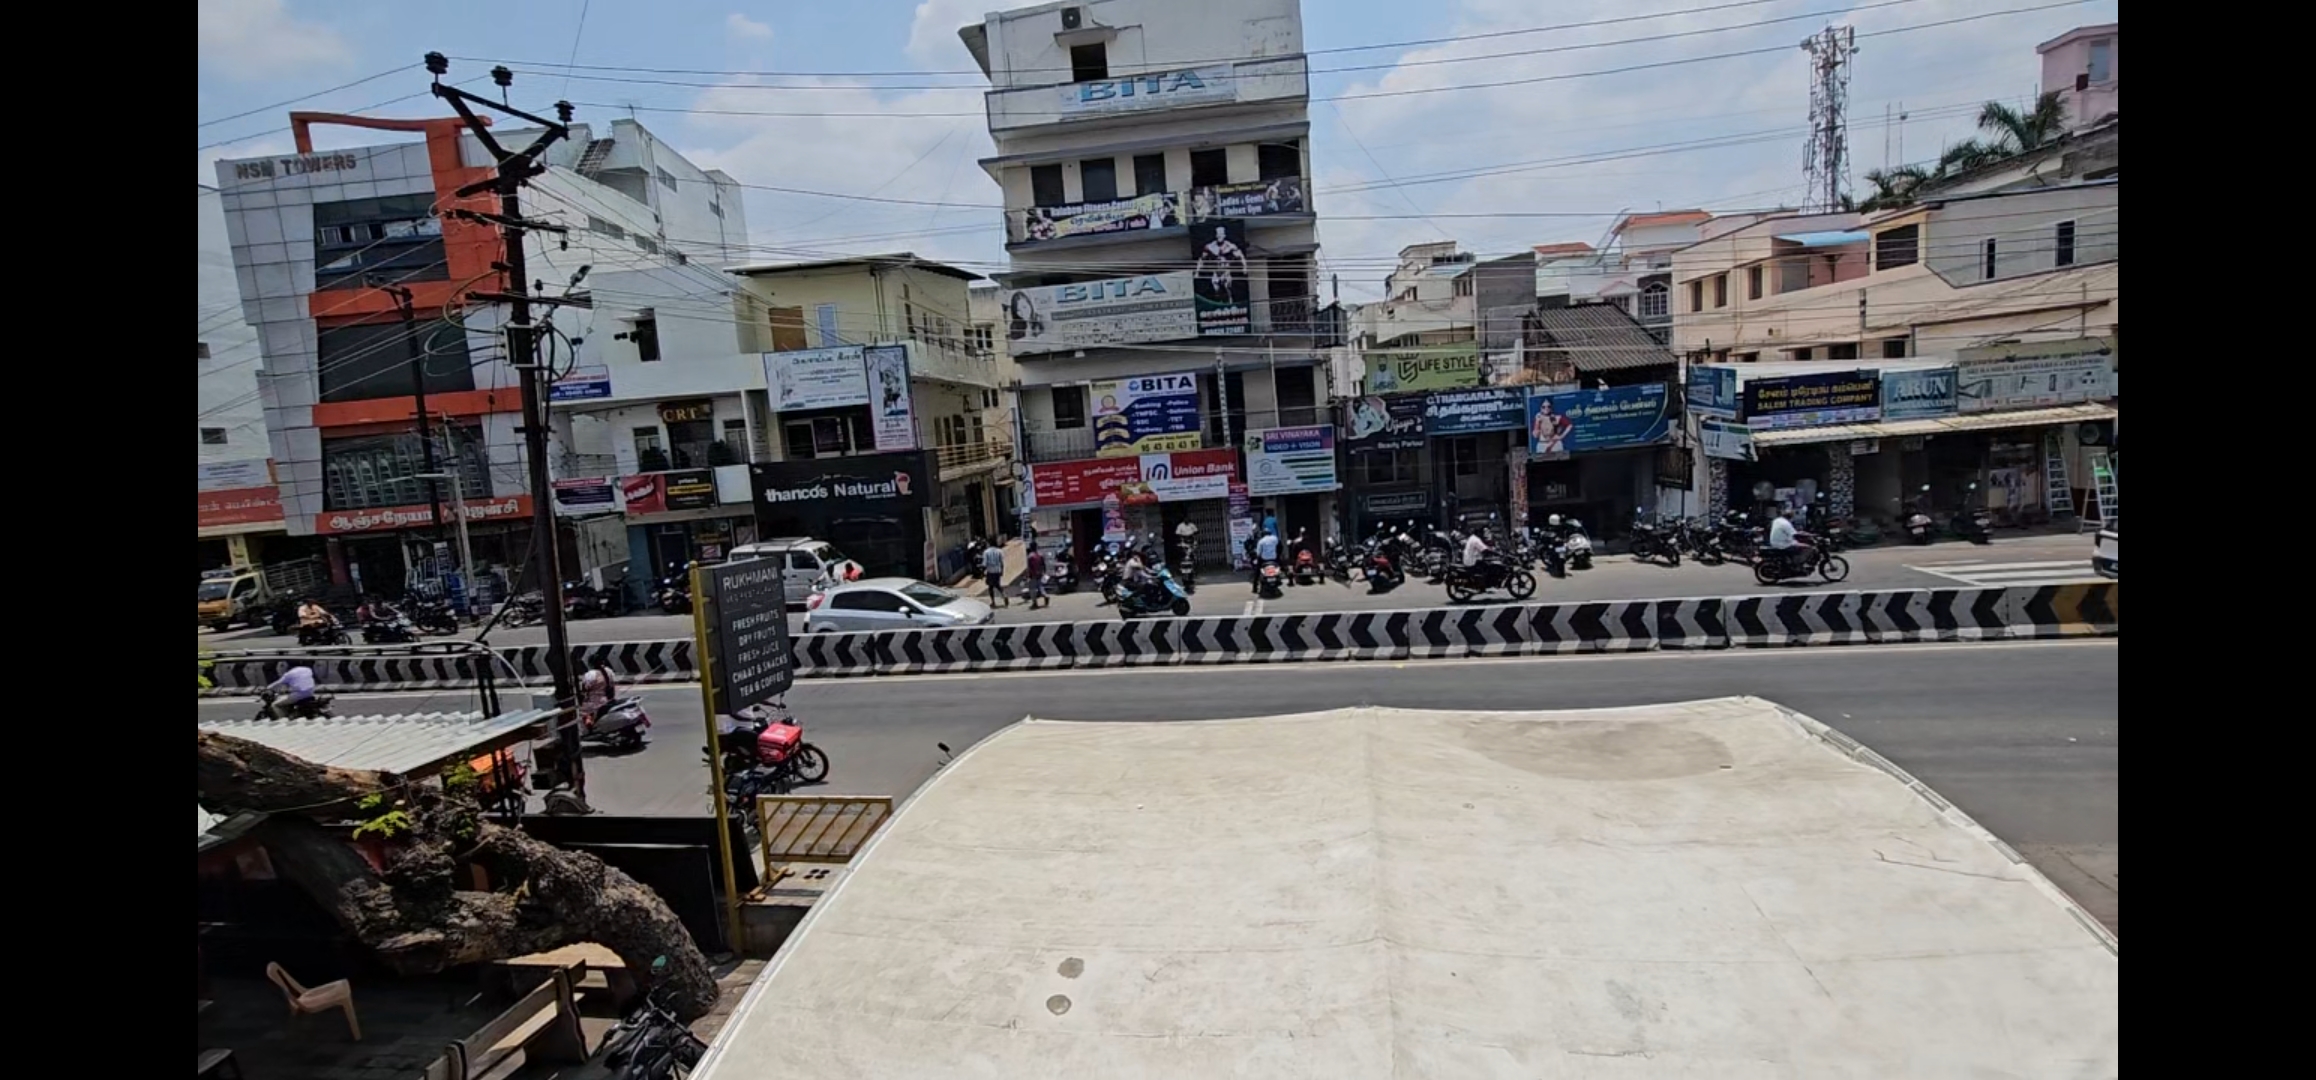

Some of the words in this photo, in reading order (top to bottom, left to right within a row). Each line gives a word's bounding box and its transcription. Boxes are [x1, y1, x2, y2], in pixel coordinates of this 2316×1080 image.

[1080, 69, 1207, 102] BITA
[281, 154, 357, 176] TOWERS
[1056, 276, 1167, 303] BITA
[1418, 359, 1440, 371] LIFE
[1442, 355, 1475, 369] STYLE
[1141, 376, 1194, 392] BITA
[1893, 376, 1949, 401] ARUN
[1757, 401, 1787, 410] SALEM
[1790, 397, 1828, 407] TRADING
[1830, 394, 1873, 404] COMPANY
[662, 406, 699, 422] CRT
[1265, 432, 1279, 440] SRI
[1280, 430, 1320, 439] VINAYAKA
[1266, 443, 1289, 451] VIDEO
[1174, 465, 1205, 476] Union
[1206, 461, 1235, 473] Bank
[834, 479, 896, 498] Natural
[329, 510, 433, 530] ஆஞ்சநேயா
[722, 566, 778, 591] RUKHMANI
[732, 616, 755, 632] FRESH
[755, 609, 779, 624] FRUITS
[738, 633, 752, 647] DRY
[753, 625, 776, 640] FRUITS
[738, 649, 760, 665] FRESH
[761, 640, 779, 655] JUICE
[732, 667, 756, 684] CHAAT
[762, 653, 788, 671] SNACKS
[739, 685, 754, 698] TEA
[761, 670, 785, 689] COFFEE
